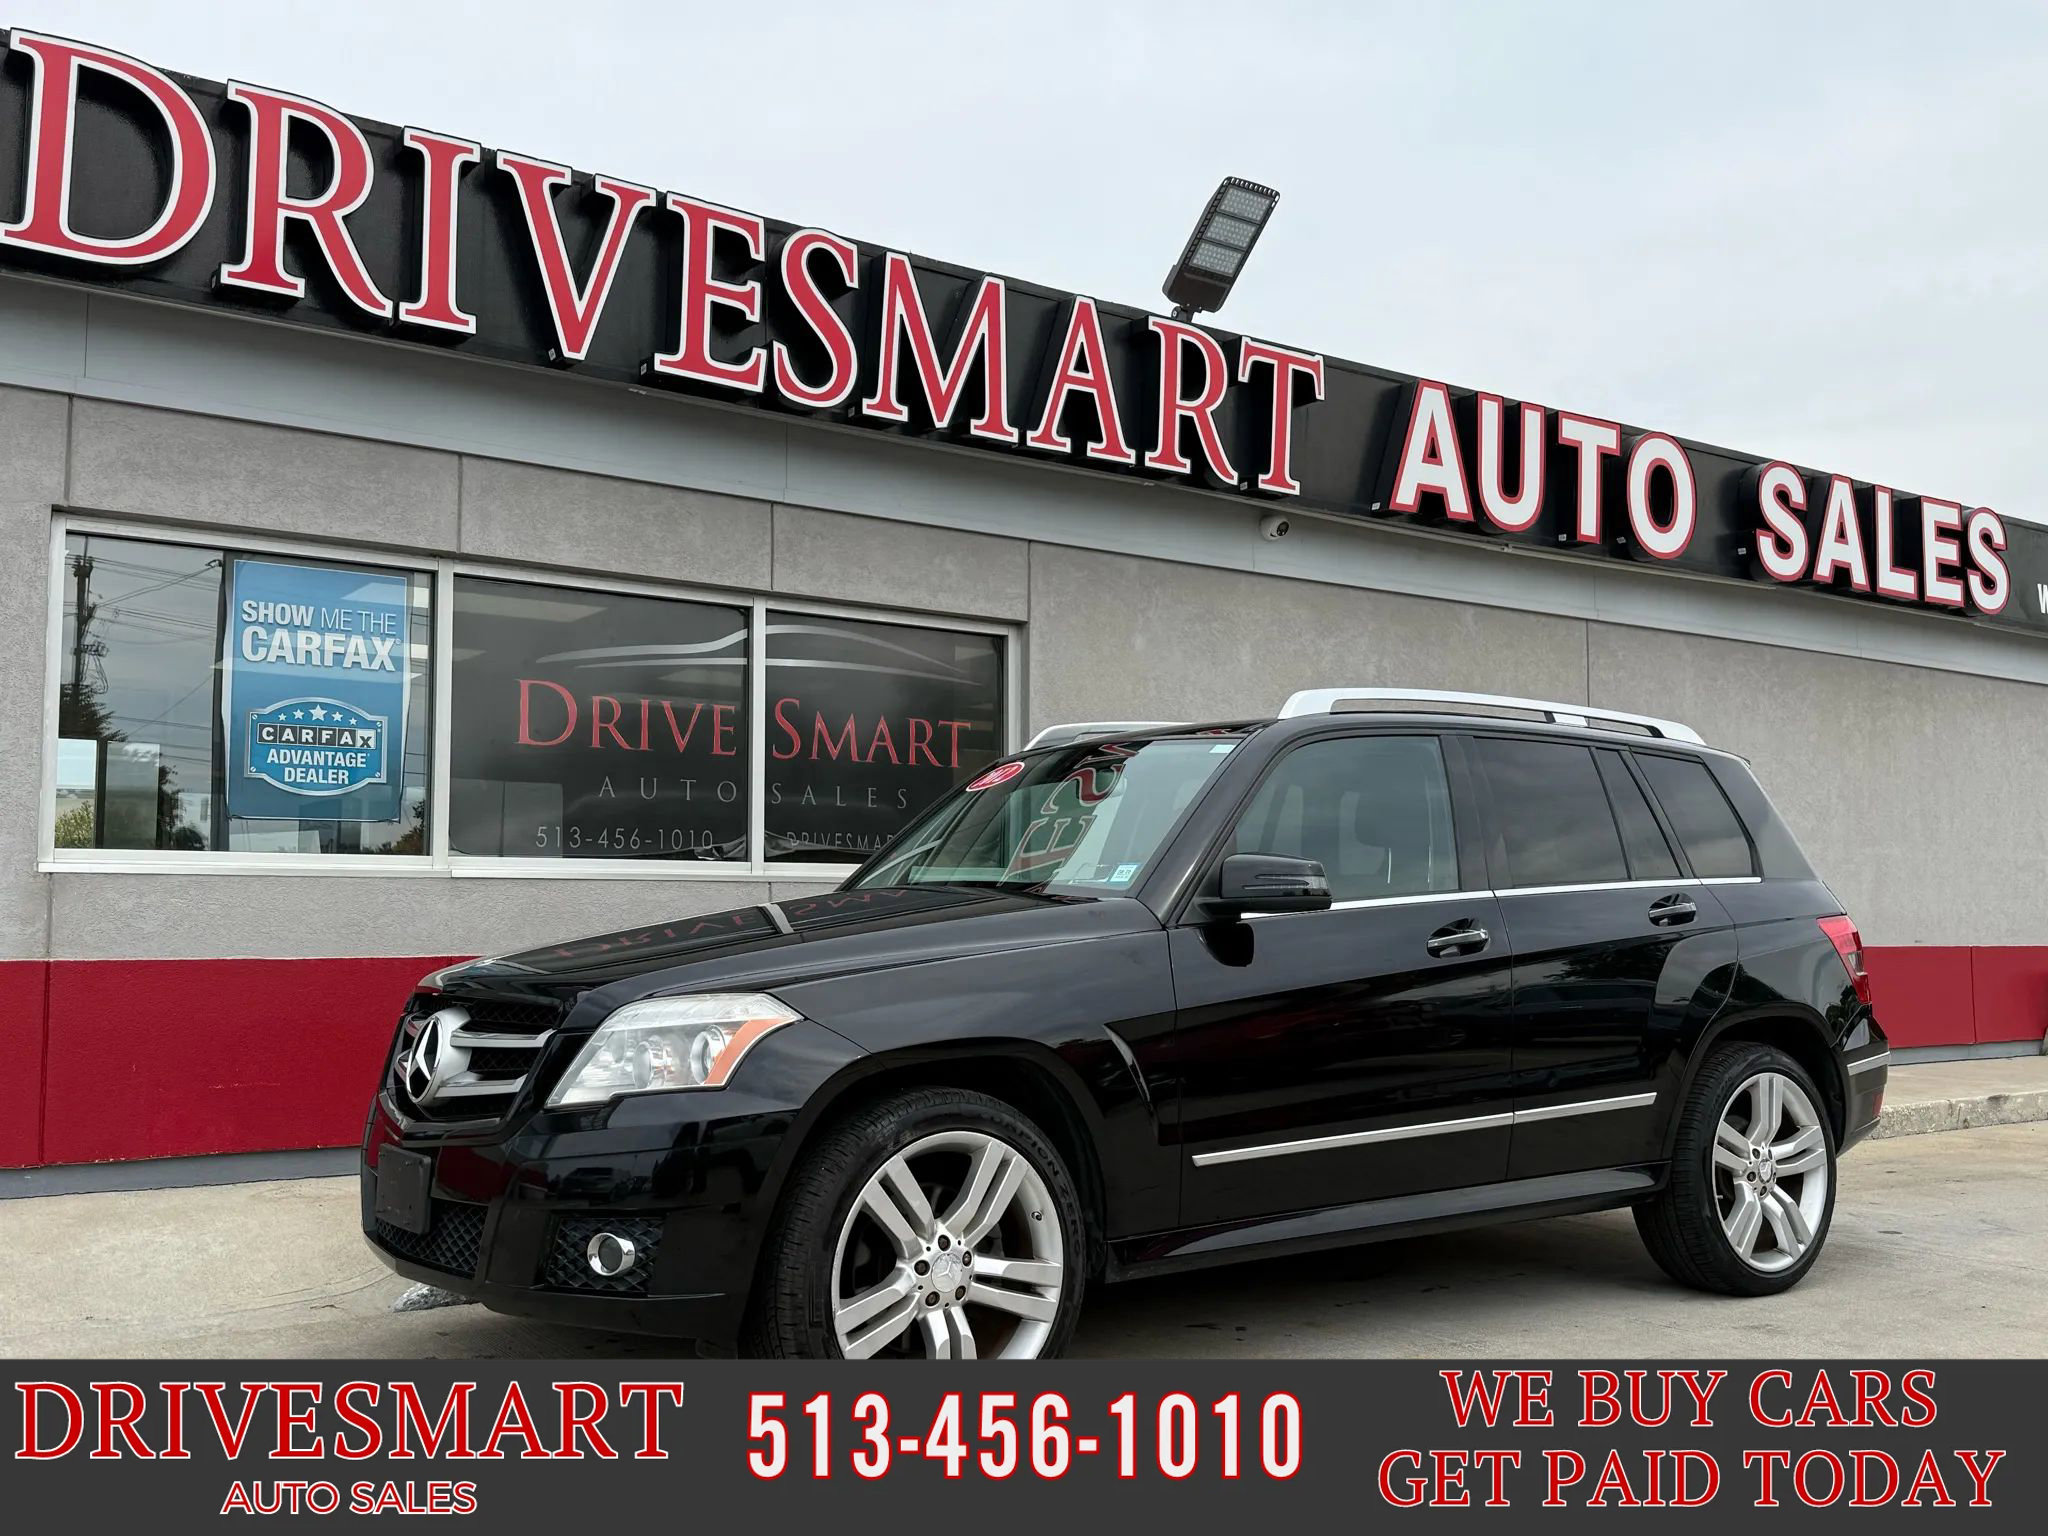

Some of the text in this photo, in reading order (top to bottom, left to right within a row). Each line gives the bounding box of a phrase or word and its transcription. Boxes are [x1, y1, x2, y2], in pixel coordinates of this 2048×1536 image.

[0, 27, 2011, 614] DRIVESMART AUTO SALES
[241, 599, 397, 635] SHOW ME THE
[242, 627, 396, 672] CARFAX
[260, 726, 374, 748] CARFAX
[266, 748, 368, 768] ADVANTAGE
[284, 767, 350, 785] DEALER
[598, 776, 908, 810] AUTO SALES
[535, 826, 713, 850] 513-456-1010
